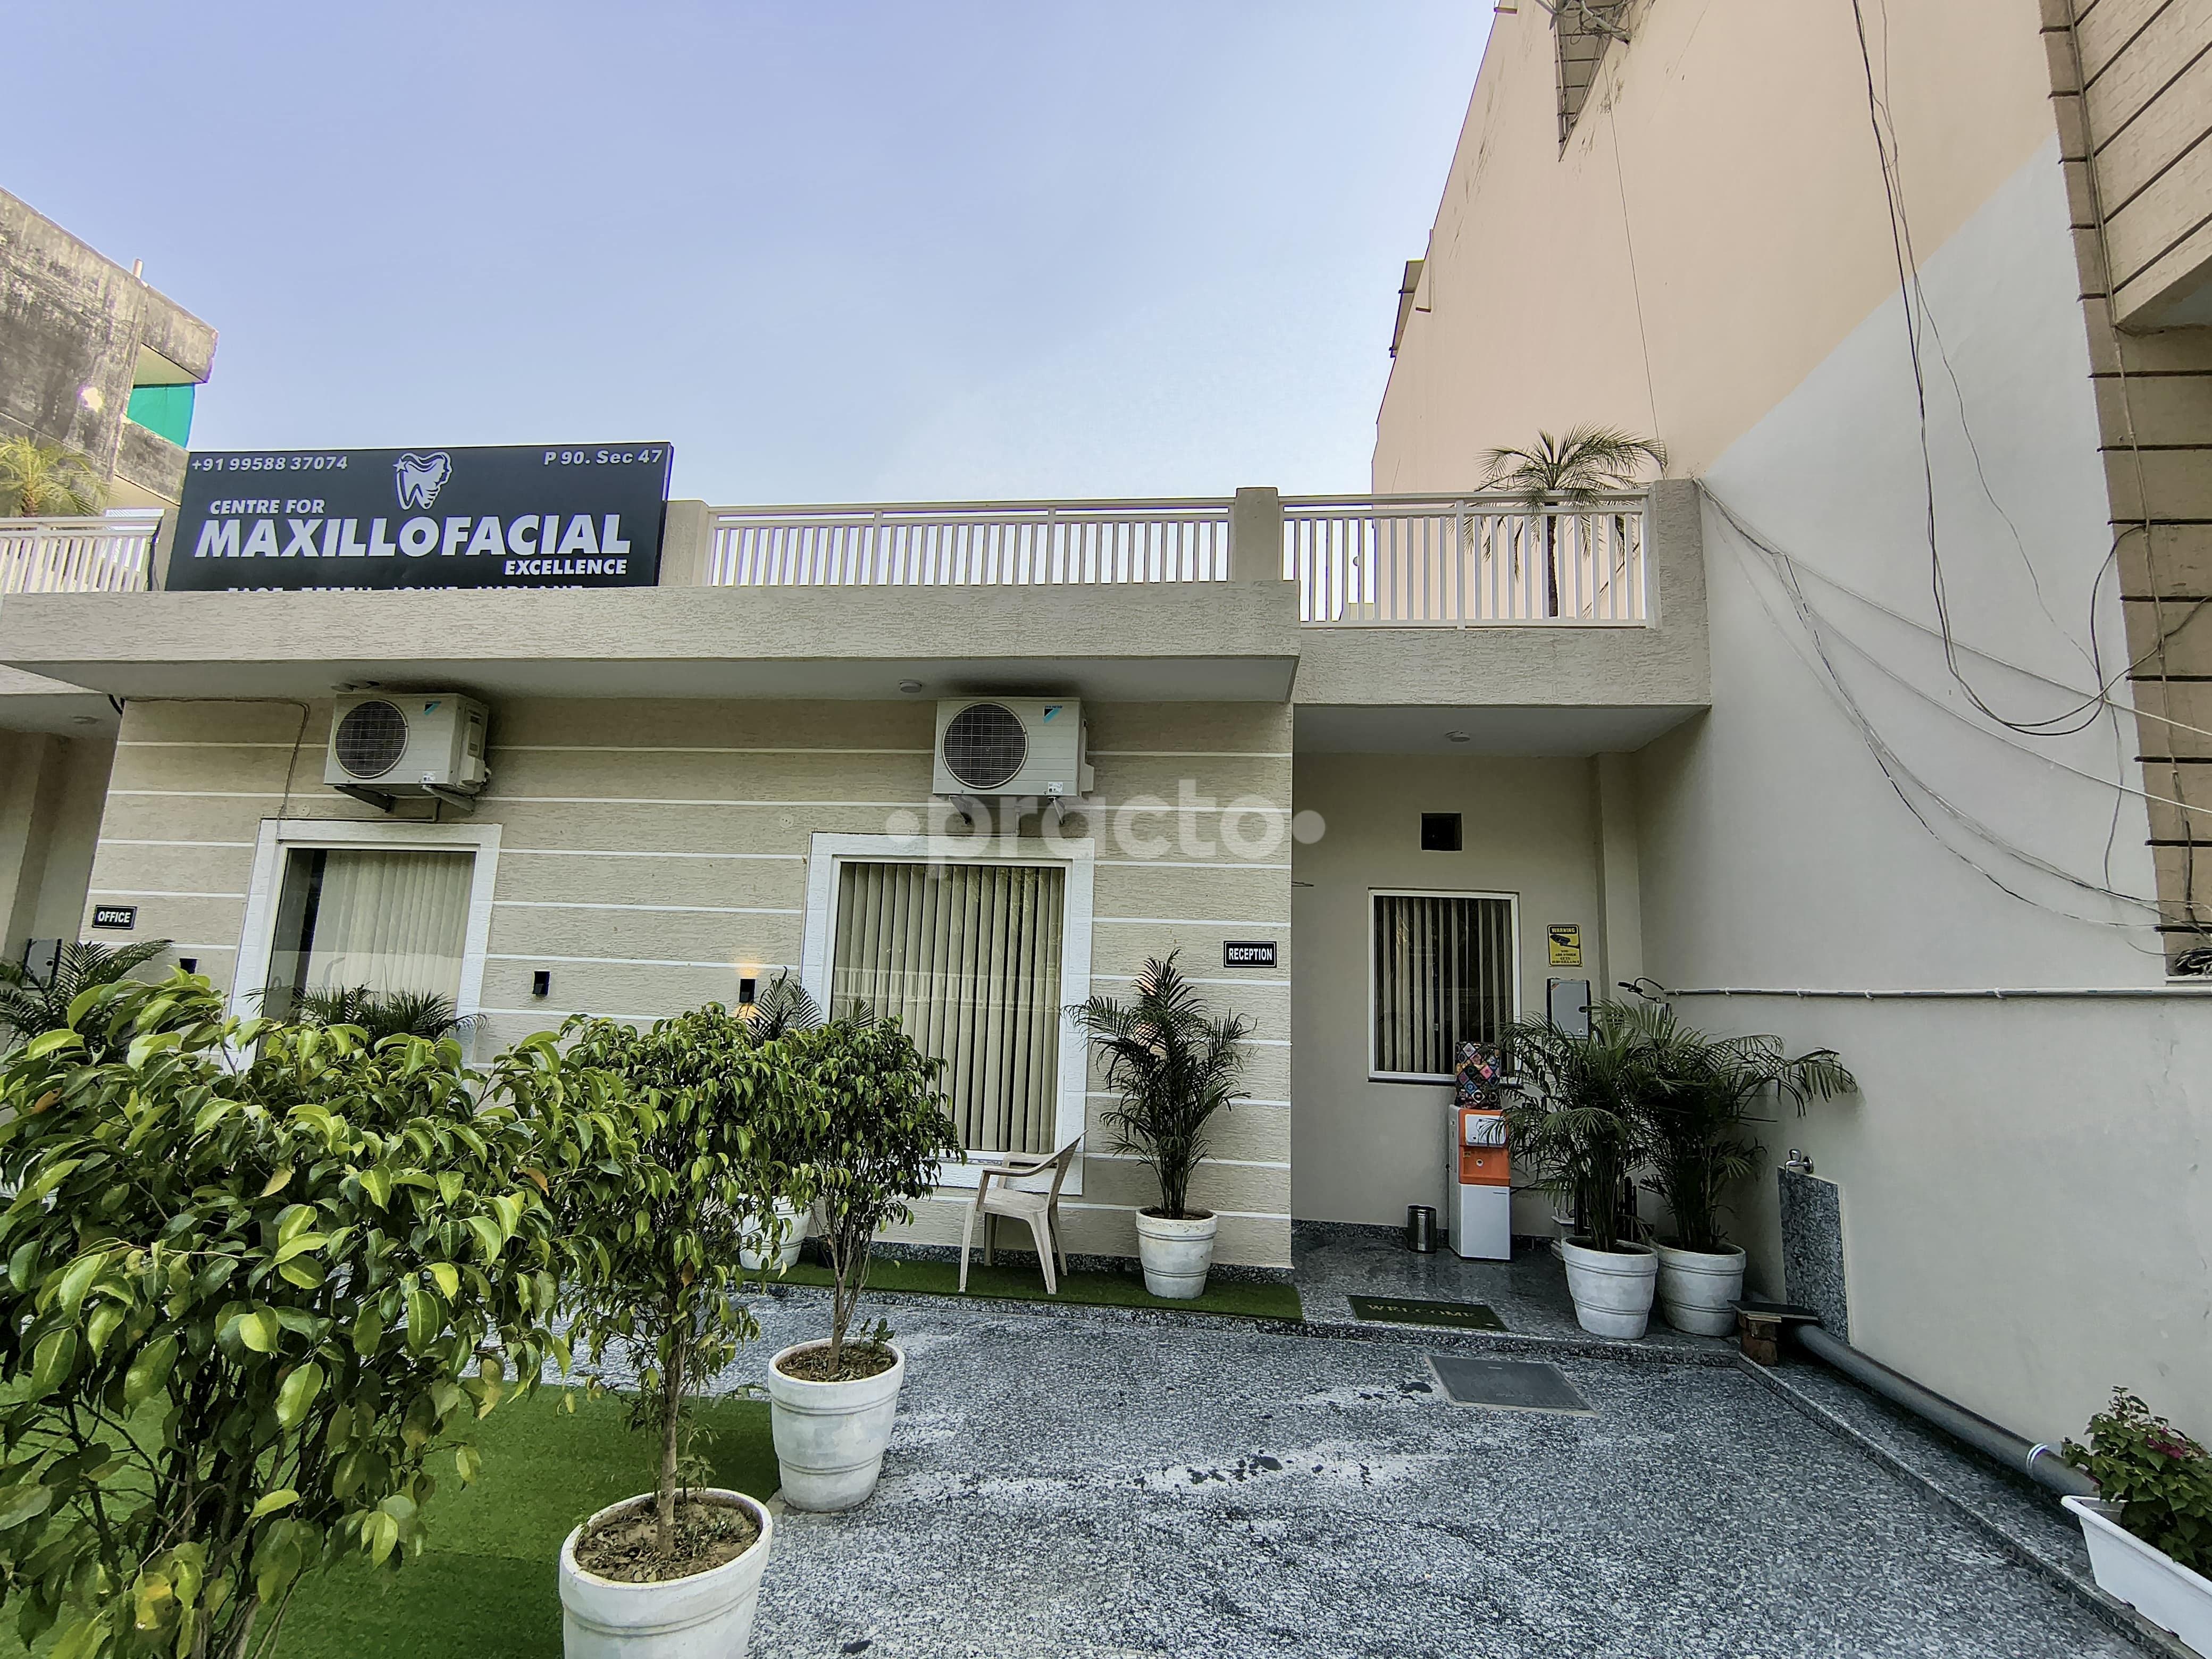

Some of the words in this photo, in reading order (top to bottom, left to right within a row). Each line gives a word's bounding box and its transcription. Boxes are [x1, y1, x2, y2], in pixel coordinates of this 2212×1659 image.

[192, 458, 224, 471] +91
[229, 457, 286, 471] 99588
[290, 456, 348, 470] 37074
[544, 451, 557, 465] P
[560, 451, 591, 465] 90.
[596, 450, 633, 464] Sec
[638, 449, 663, 463] 47
[210, 499, 280, 515] CENTRE
[285, 499, 325, 514] FOR
[193, 514, 631, 558] MAXILLOFACIAL
[504, 559, 627, 575] EXCELLENCE
[98, 911, 131, 923] OFFICE
[1228, 948, 1272, 961] RECEPTION
